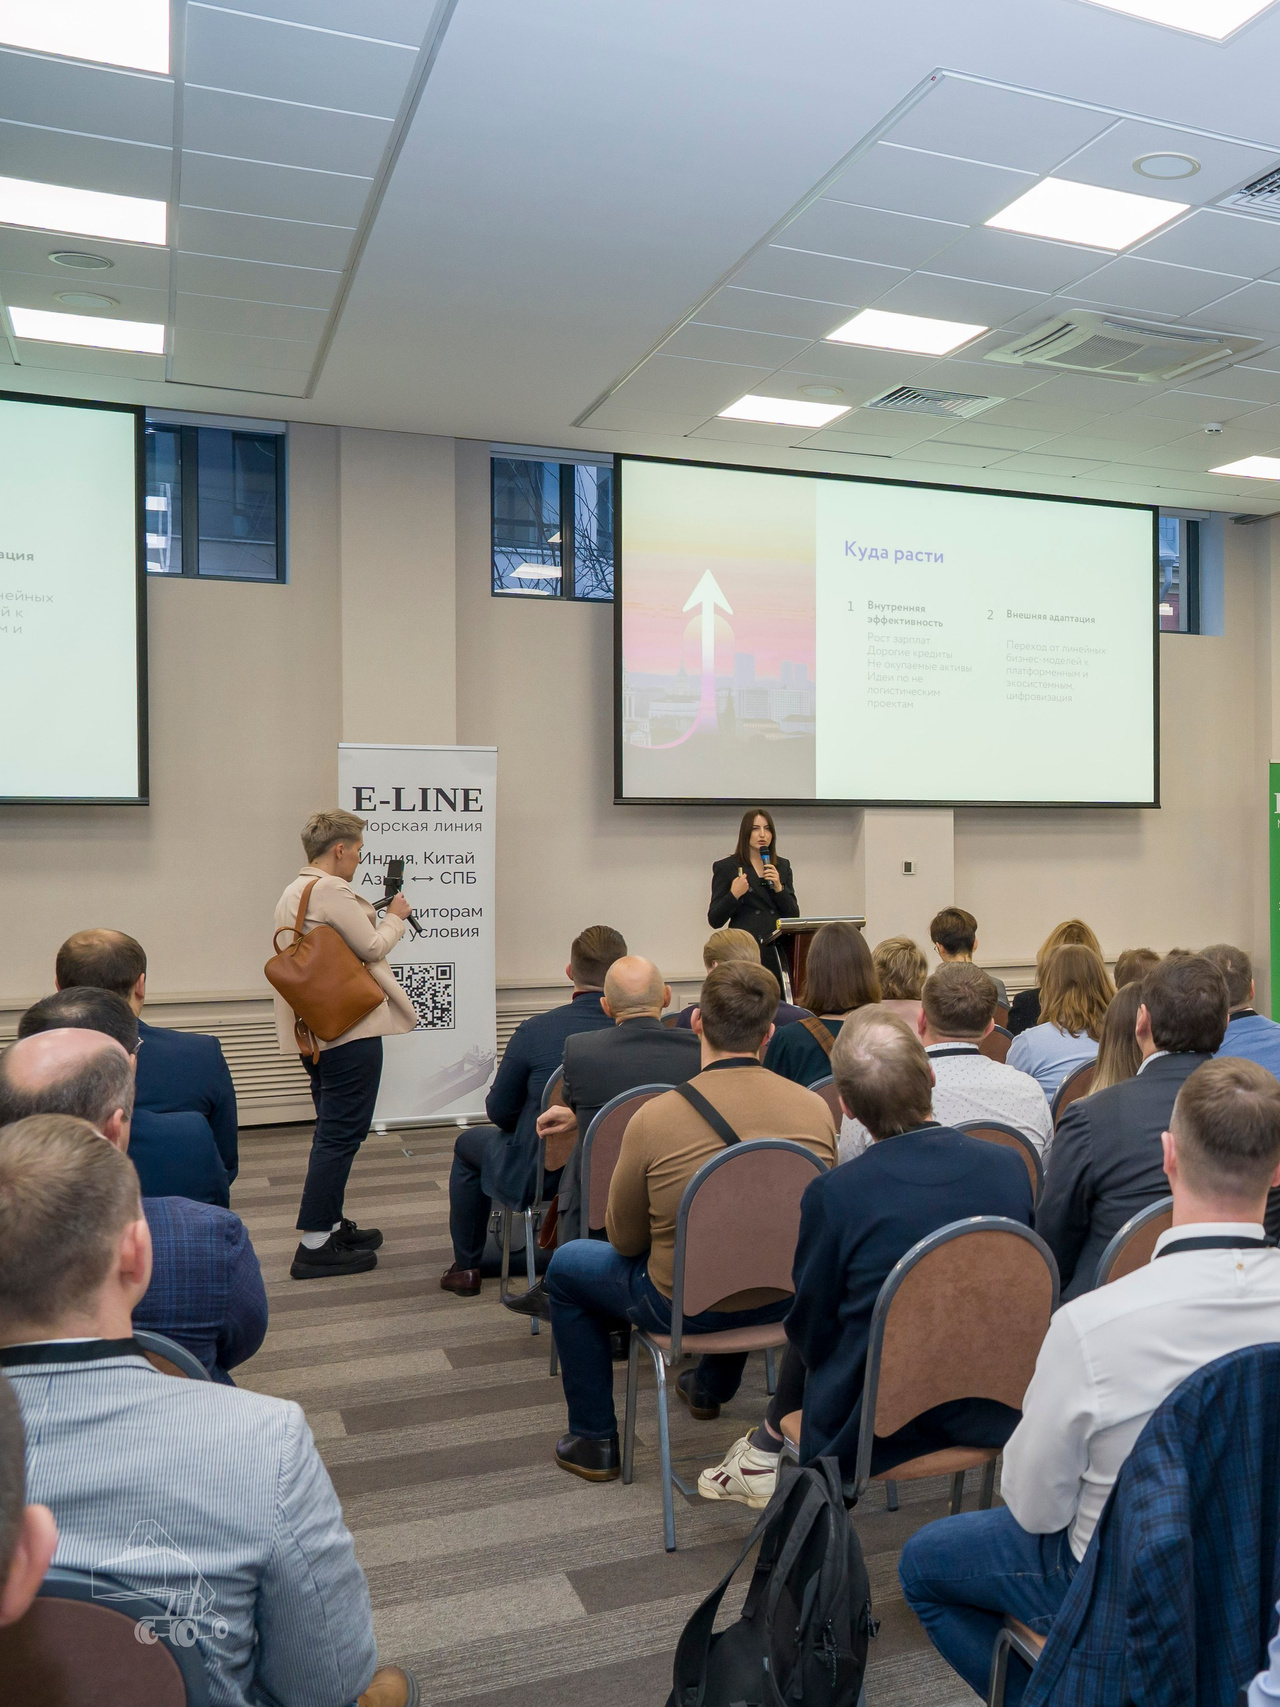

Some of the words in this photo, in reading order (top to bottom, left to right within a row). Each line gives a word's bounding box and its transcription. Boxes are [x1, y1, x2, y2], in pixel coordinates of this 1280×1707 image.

[844, 540, 889, 562] Куда
[894, 548, 944, 564] расти
[847, 601, 854, 612] 1
[867, 600, 926, 613] Внутренняя
[987, 609, 994, 620] 2
[1006, 609, 1047, 620] Внешняя
[1049, 614, 1096, 624] адаптация
[867, 615, 944, 628] эффективность
[867, 632, 890, 643] Рост
[893, 636, 931, 646] зарплат
[867, 645, 910, 657] Дорогие
[912, 650, 953, 659] кредиты
[1006, 639, 1047, 652] Переход
[1062, 645, 1106, 654] линейных
[1006, 652, 1082, 665] бизнес-моделей
[867, 659, 882, 668] Не
[884, 661, 938, 672] окупаемые
[939, 664, 973, 673] активы
[1006, 666, 1080, 677] платформенным
[867, 672, 894, 683] Идеи
[896, 674, 909, 682] по
[911, 675, 923, 683] не
[867, 687, 941, 697] логистическим
[1006, 680, 1075, 691] экосистемным,
[1006, 691, 1073, 702] цифровизация
[867, 700, 914, 709] проектам
[352, 786, 484, 813] E-LINE
[364, 819, 428, 835] орская
[434, 822, 482, 832] линия
[424, 851, 475, 864] Китай
[440, 871, 477, 885] СПБ
[408, 927, 479, 942] условия
